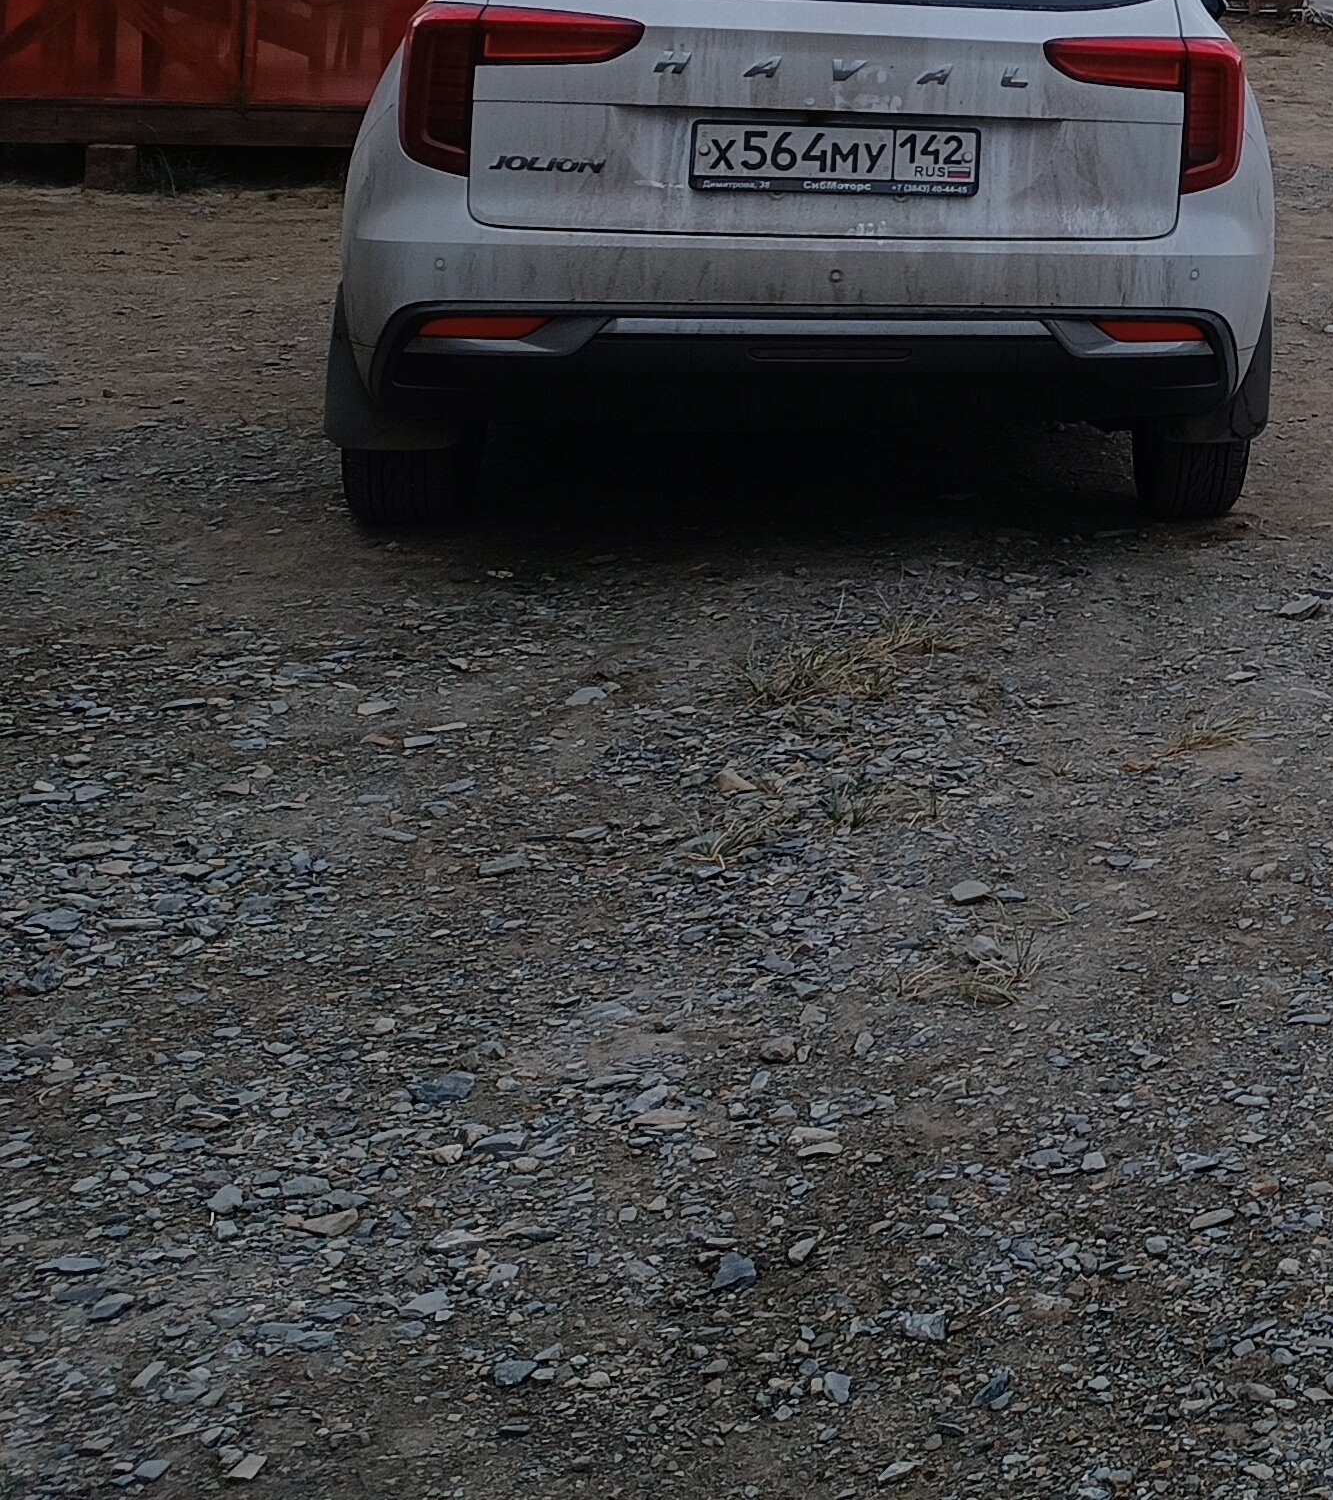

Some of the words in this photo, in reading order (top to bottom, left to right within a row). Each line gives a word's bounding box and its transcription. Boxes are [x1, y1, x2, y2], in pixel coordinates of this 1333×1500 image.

[652, 50, 1029, 88] HAVAL
[709, 131, 887, 174] Х564МУ
[898, 134, 963, 165] 142
[488, 155, 606, 173] JOLION
[914, 165, 946, 178] RUS
[803, 180, 872, 192] СибМоторс
